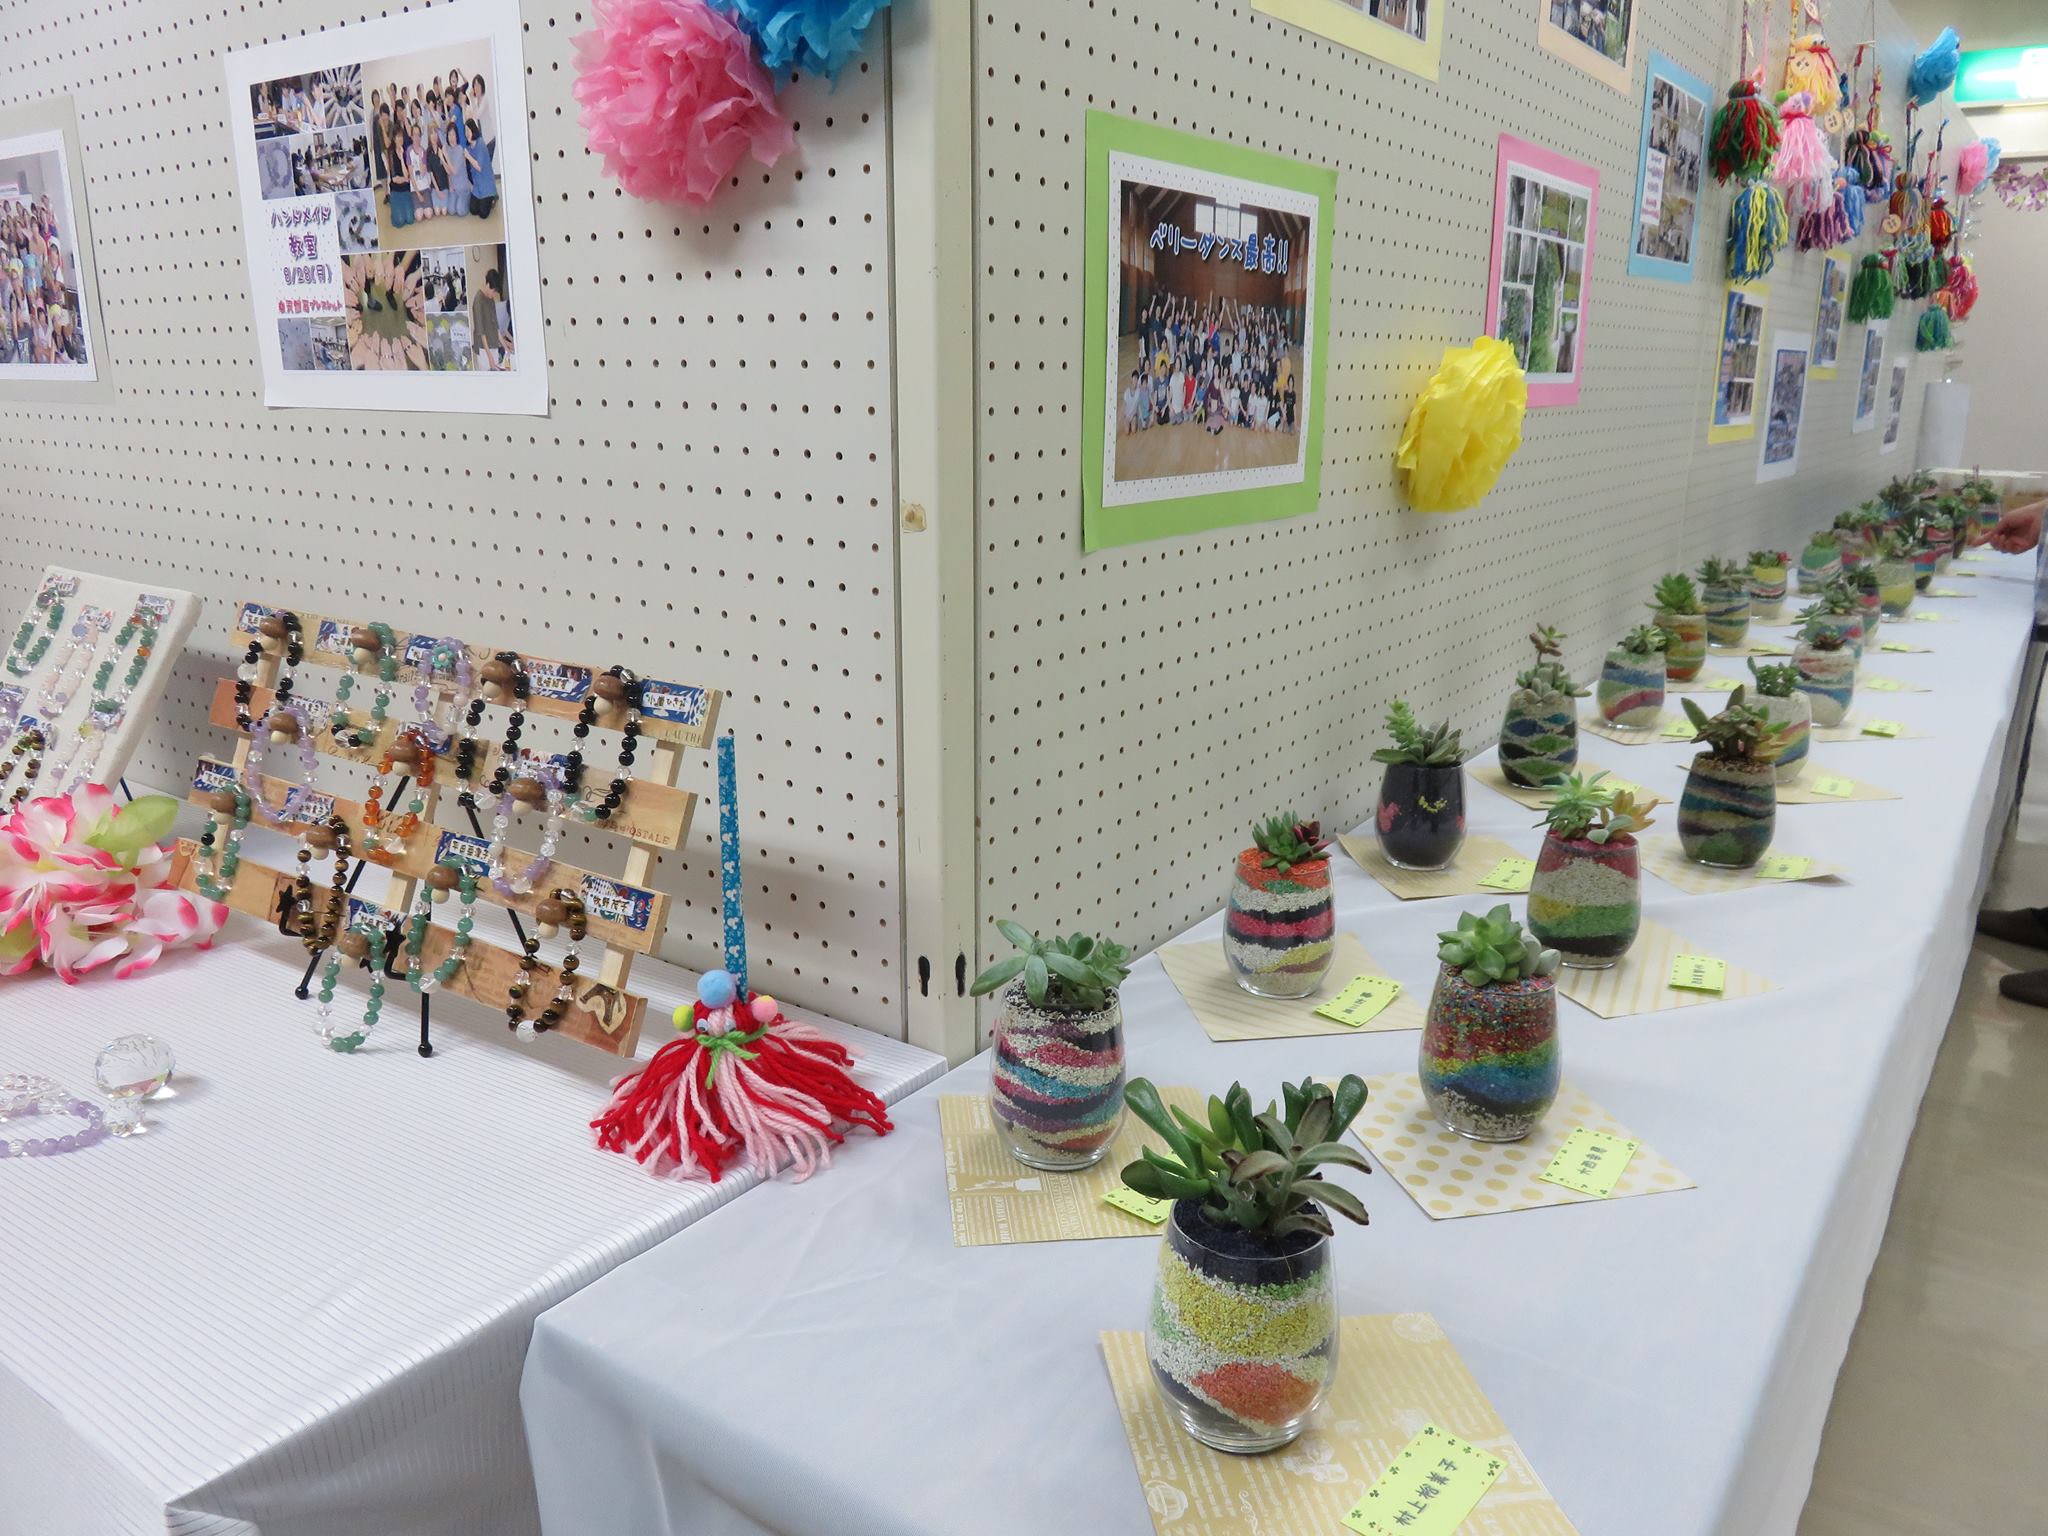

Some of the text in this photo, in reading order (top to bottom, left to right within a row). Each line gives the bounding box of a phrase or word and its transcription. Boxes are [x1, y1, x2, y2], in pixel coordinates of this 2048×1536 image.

[271, 206, 331, 228] ハンドメイド
[288, 231, 318, 260] 教室
